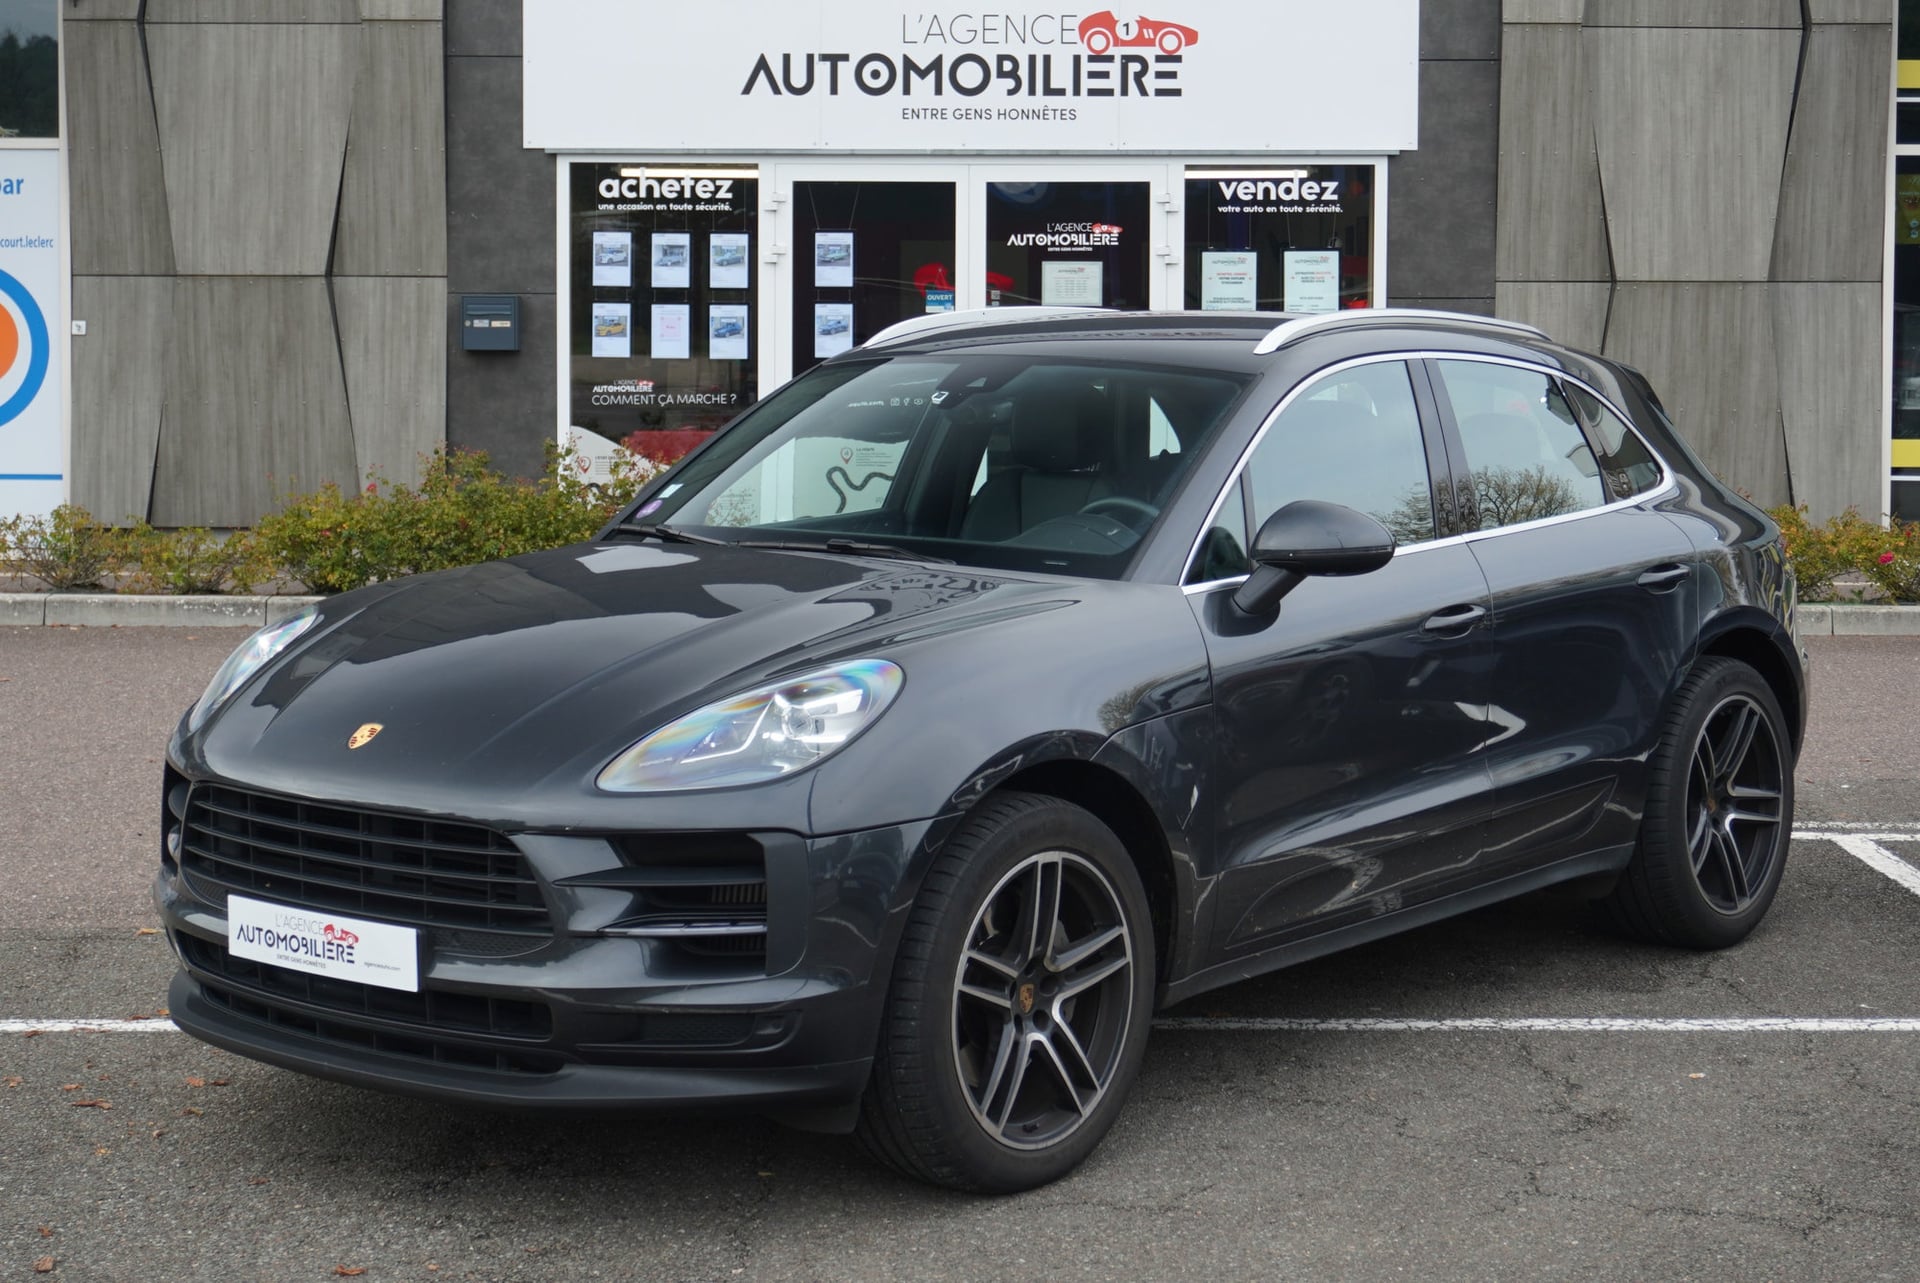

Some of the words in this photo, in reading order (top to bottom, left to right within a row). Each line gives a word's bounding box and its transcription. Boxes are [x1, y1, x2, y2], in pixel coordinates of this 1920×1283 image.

[902, 14, 1079, 45] L'AGENCE
[1122, 22, 1131, 36] 1
[902, 107, 948, 121] ENTRE
[953, 107, 993, 121] GENS
[997, 104, 1078, 121] HONNÊTES
[0, 178, 24, 195] ar
[598, 166, 734, 199] achetez
[1218, 168, 1340, 201] vendez
[598, 203, 615, 211] une
[616, 201, 654, 211] occasion
[656, 203, 668, 211] en
[669, 202, 694, 211] toute
[695, 201, 733, 211] sécurité.
[1217, 205, 1241, 213] votre
[1243, 205, 1264, 213] auto
[1279, 205, 1303, 213] toute
[1305, 203, 1343, 213] sérénité.
[1047, 222, 1093, 233] L'AGENCE
[591, 394, 657, 406] COMMENT
[657, 393, 675, 407] ÇA
[676, 393, 728, 405] MARCHE
[730, 393, 737, 405] ?
[275, 913, 325, 936] L'AGENCE
